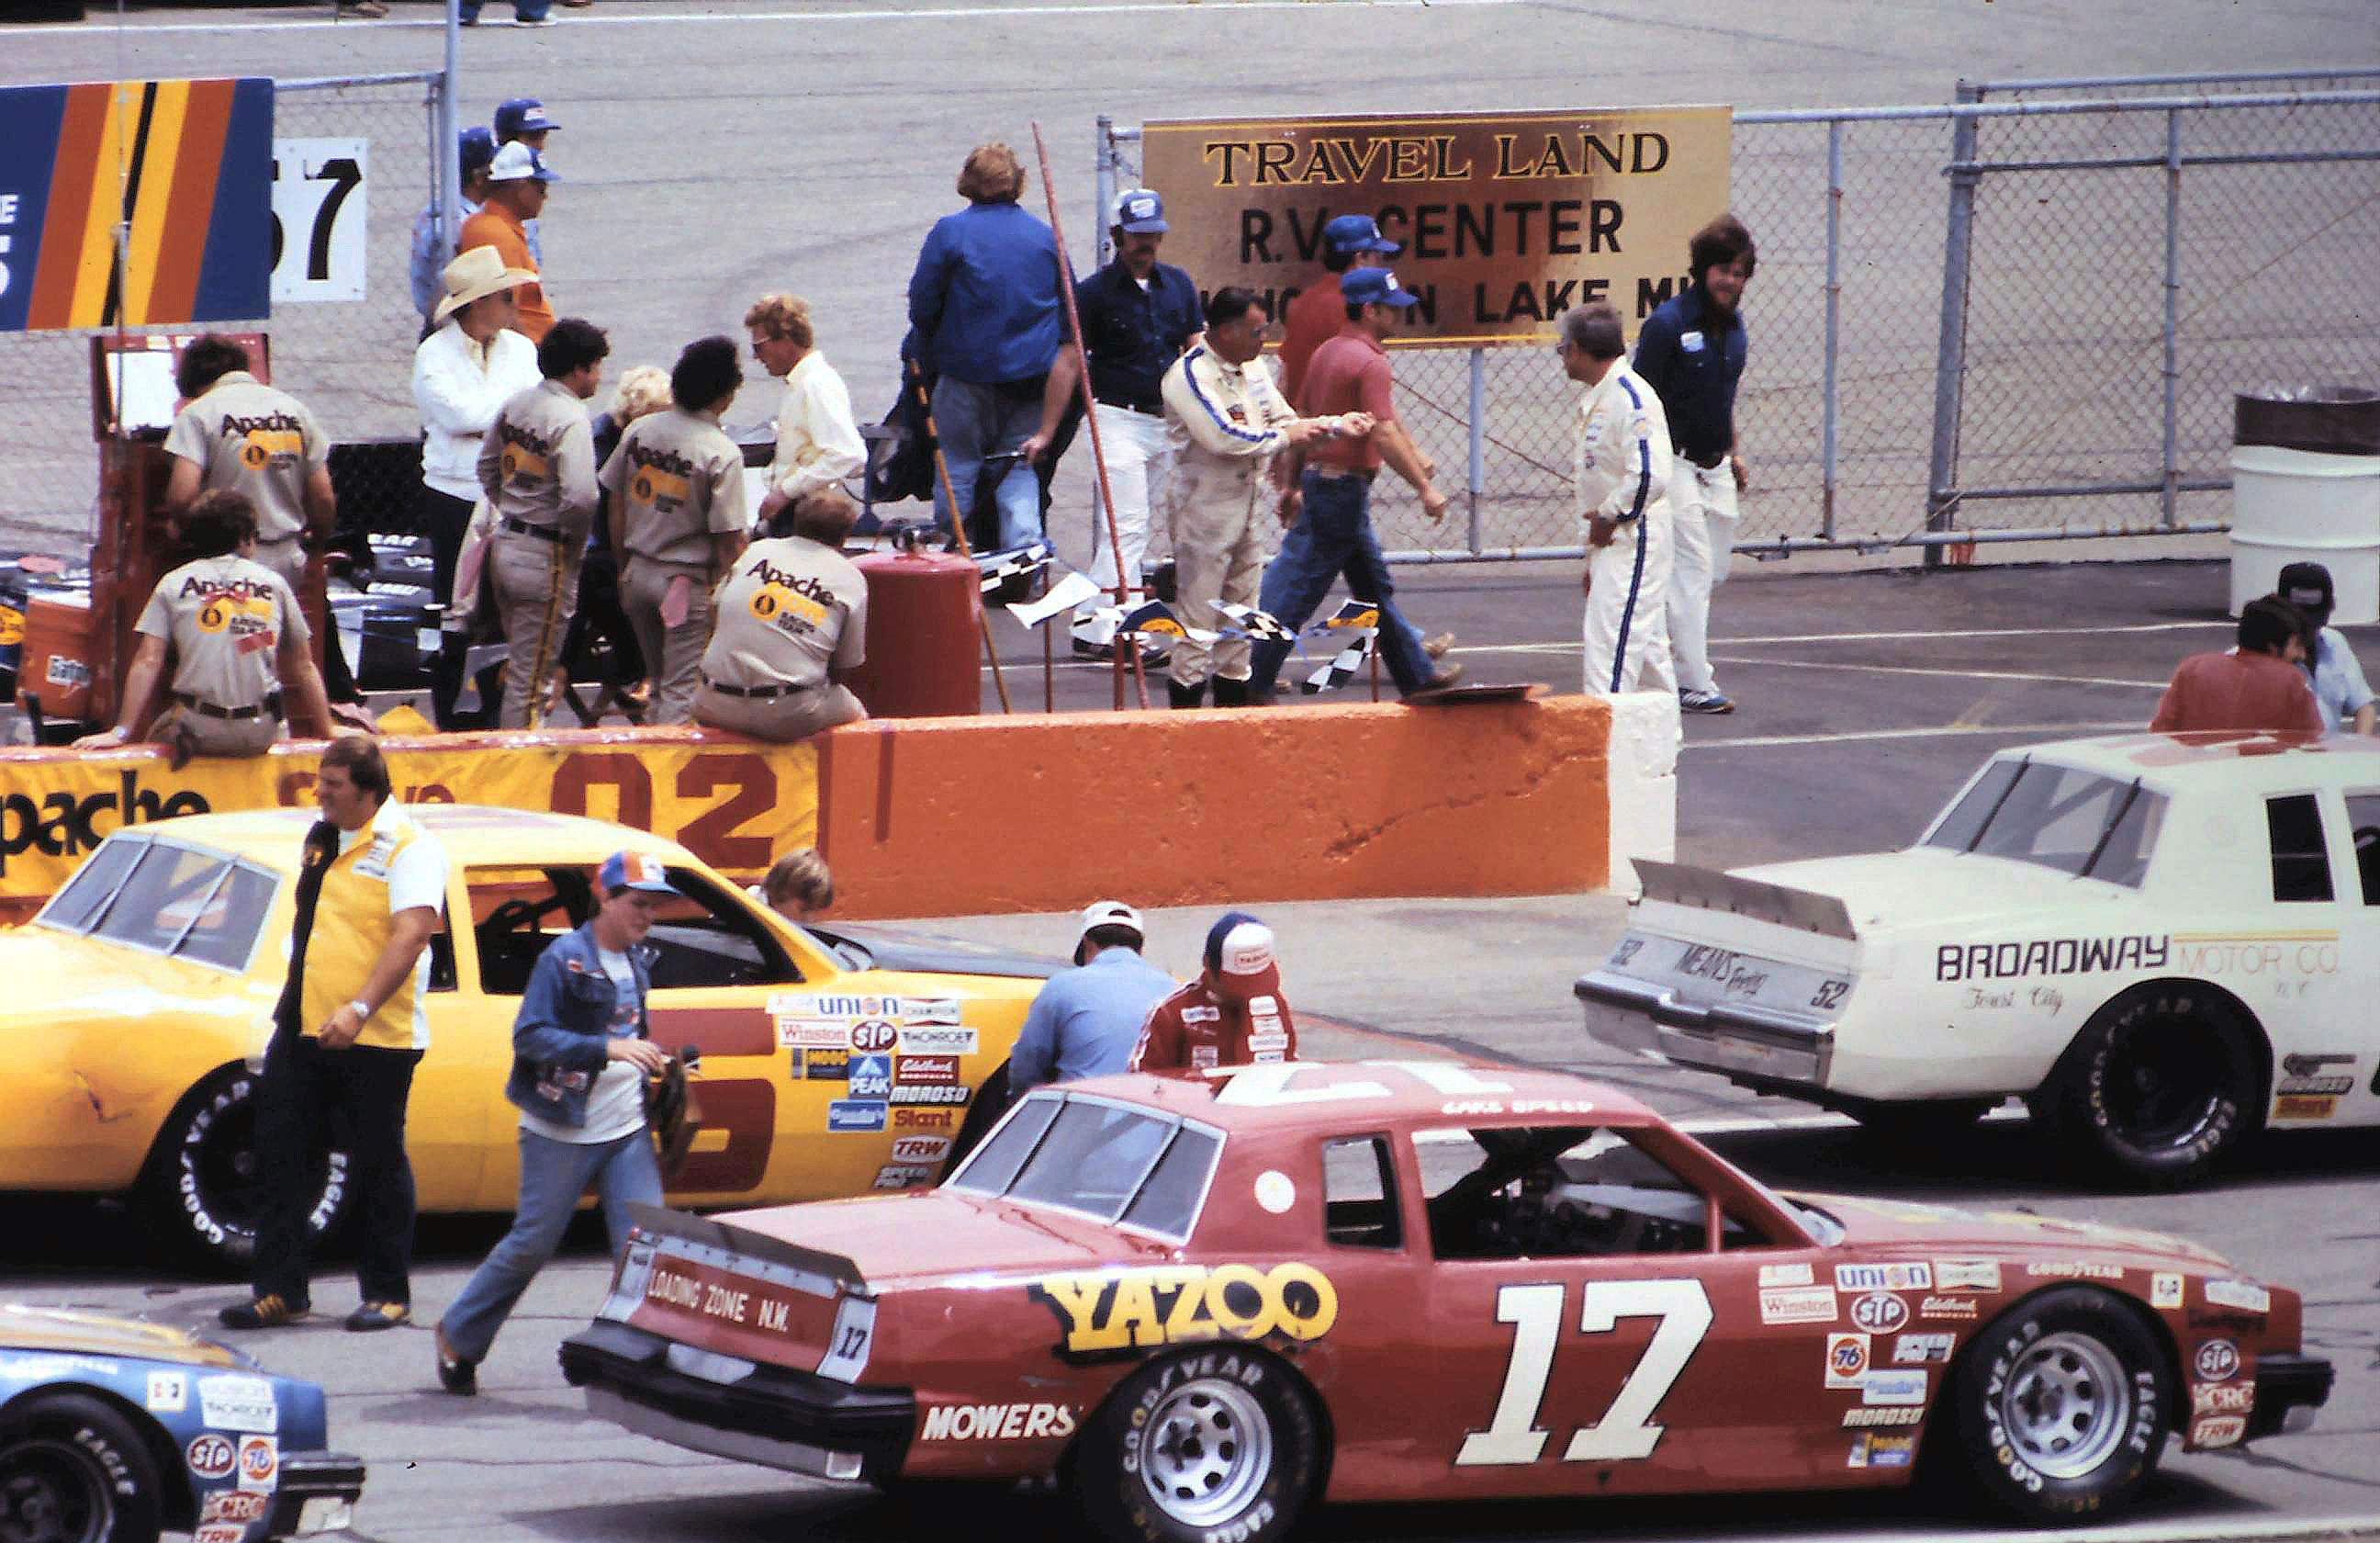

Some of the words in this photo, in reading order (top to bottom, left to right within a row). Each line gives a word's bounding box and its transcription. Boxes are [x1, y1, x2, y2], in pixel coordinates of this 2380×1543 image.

[1206, 137, 1472, 186] TRAVEL
[1493, 131, 1670, 179] LAND
[221, 410, 302, 438] Apache
[179, 576, 274, 601] Apache
[747, 558, 835, 607] Apache
[1937, 935, 2169, 981] BROADWAY
[2180, 945, 2282, 974] MOTOR
[1810, 979, 1849, 1009] 52
[782, 1023, 845, 1041] Winston
[852, 1021, 897, 1049] STP
[849, 1077, 891, 1095] PEAK
[894, 1109, 952, 1127] Stant
[896, 1142, 947, 1154] TRW
[703, 1282, 749, 1323] ZONE
[1041, 1261, 1339, 1352] YAZOO
[1763, 1296, 1830, 1312] Winston
[1857, 1293, 1903, 1327] STP
[836, 1326, 868, 1359] 17
[1836, 1346, 1861, 1367] 76
[2201, 1344, 2233, 1371] STP
[1454, 1277, 1714, 1466] 17
[921, 1402, 1076, 1441] MOWERS
[1123, 1353, 1264, 1474] GOODYEAR
[2129, 1370, 2157, 1454] EAGLE
[192, 1438, 231, 1470] STP
[248, 1449, 269, 1469] 76
